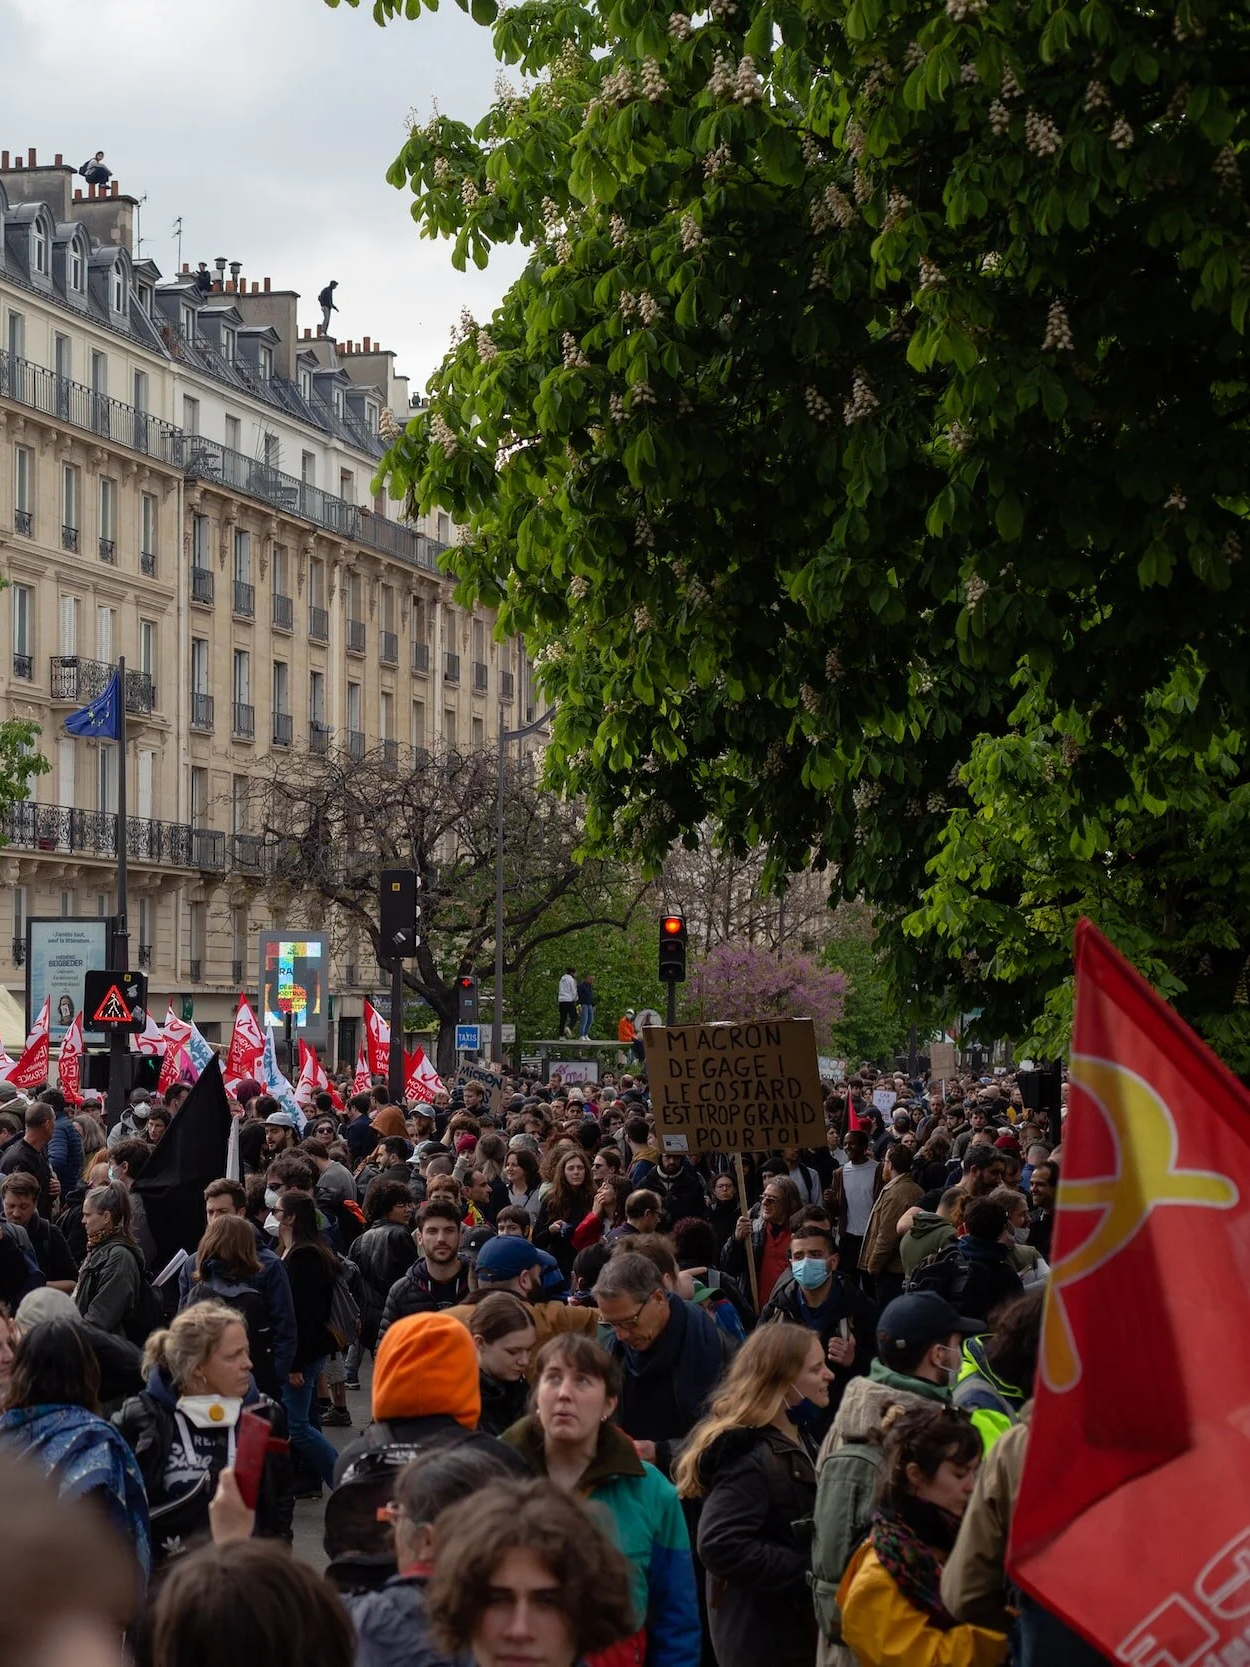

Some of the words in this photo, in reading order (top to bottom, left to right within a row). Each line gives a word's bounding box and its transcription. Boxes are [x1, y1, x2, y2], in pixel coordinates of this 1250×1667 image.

[458, 1033, 477, 1042] TAXIS
[667, 1024, 781, 1051] MACRON
[664, 1083, 690, 1104] LE
[698, 1077, 801, 1102] COSTARD
[662, 1105, 690, 1125] EST
[694, 1104, 740, 1125] TROP
[744, 1101, 815, 1126] GRAND
[696, 1128, 754, 1148] POUR
